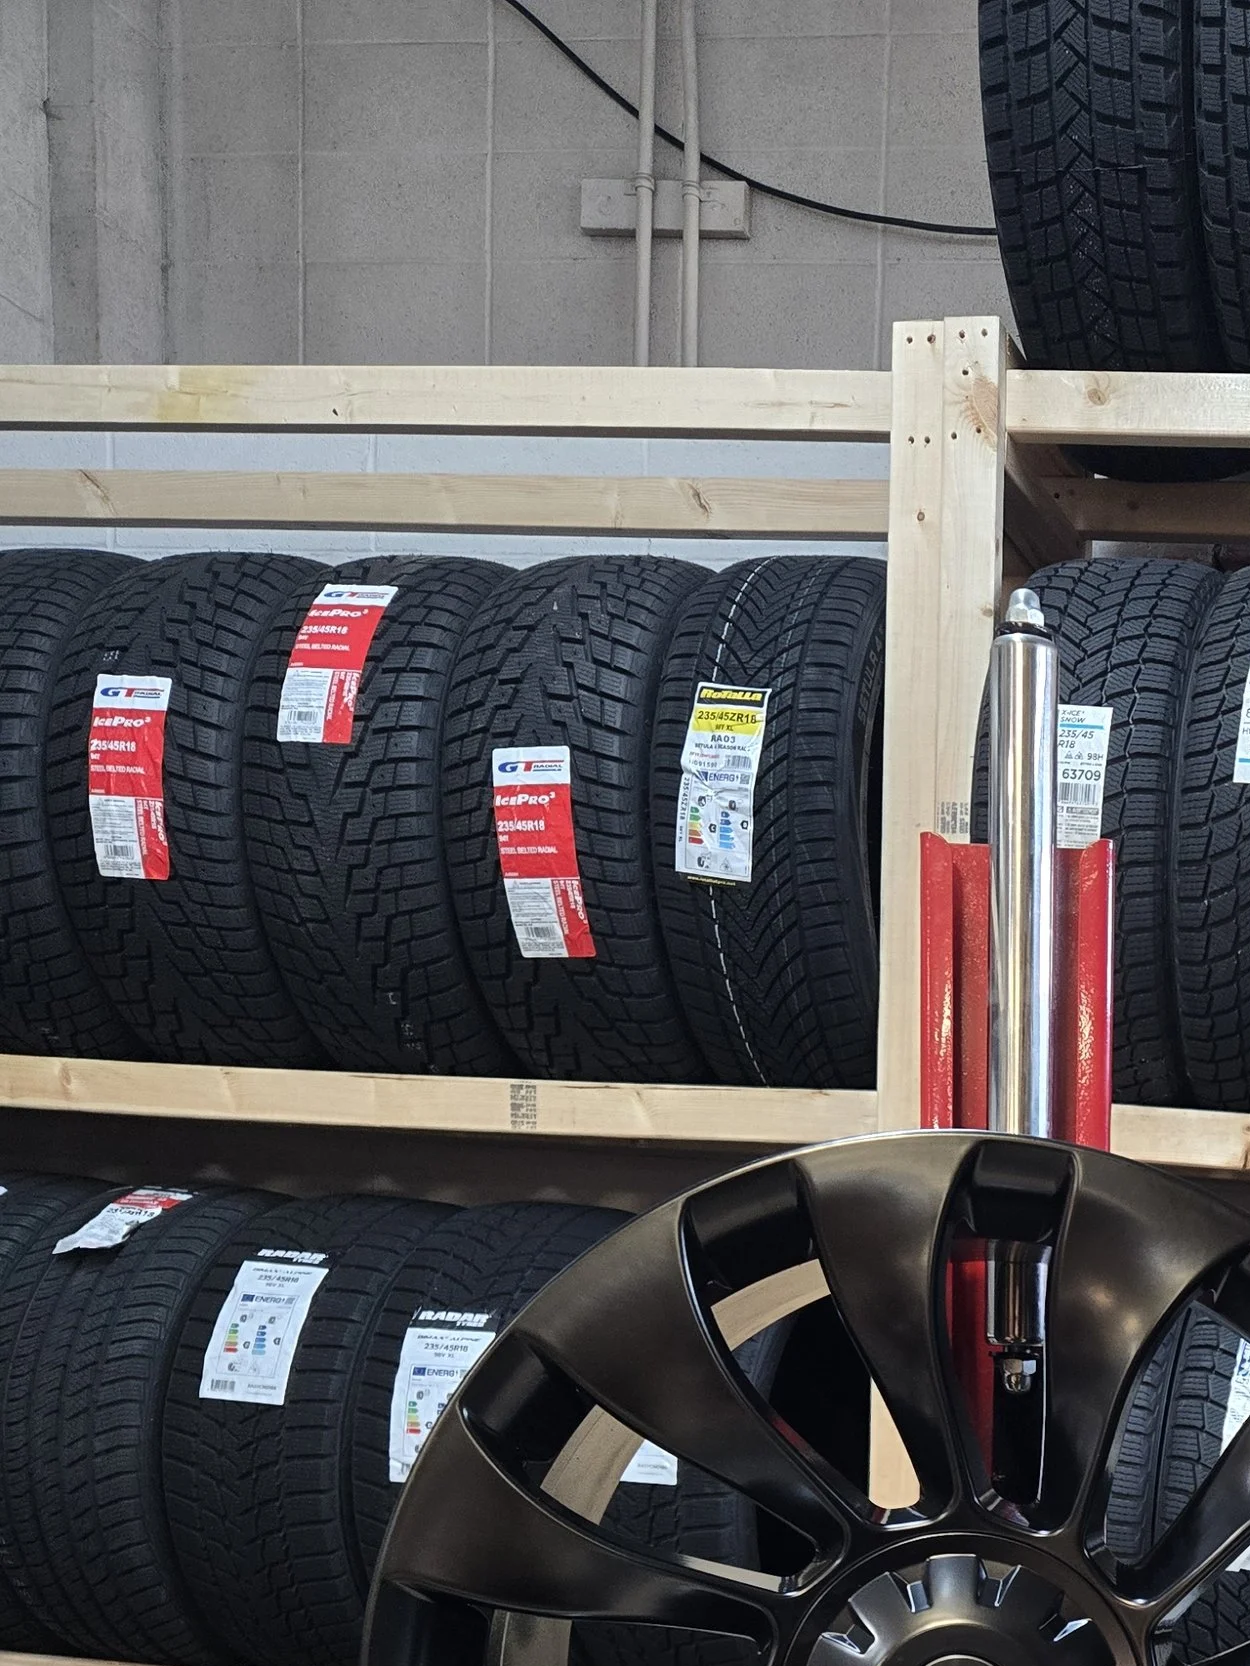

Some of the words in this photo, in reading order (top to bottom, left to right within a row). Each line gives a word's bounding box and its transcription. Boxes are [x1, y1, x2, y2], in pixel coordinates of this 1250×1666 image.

[697, 710, 757, 724] 235/45ZR18
[1060, 716, 1086, 724] SNOW
[1058, 729, 1095, 740] 235/45
[90, 738, 137, 753] 235/45R18
[1058, 740, 1076, 749] R18
[1087, 752, 1104, 761] 98H
[498, 760, 533, 773] GT
[708, 772, 736, 782] ENERG
[1061, 768, 1102, 782] 63709
[497, 819, 545, 832] 235/45R18
[257, 1248, 327, 1261] RADAR
[254, 1296, 281, 1304] ENERG
[418, 1310, 490, 1323] RADAR
[423, 1342, 469, 1353] 235/45R18
[426, 1369, 455, 1377] ENERG
